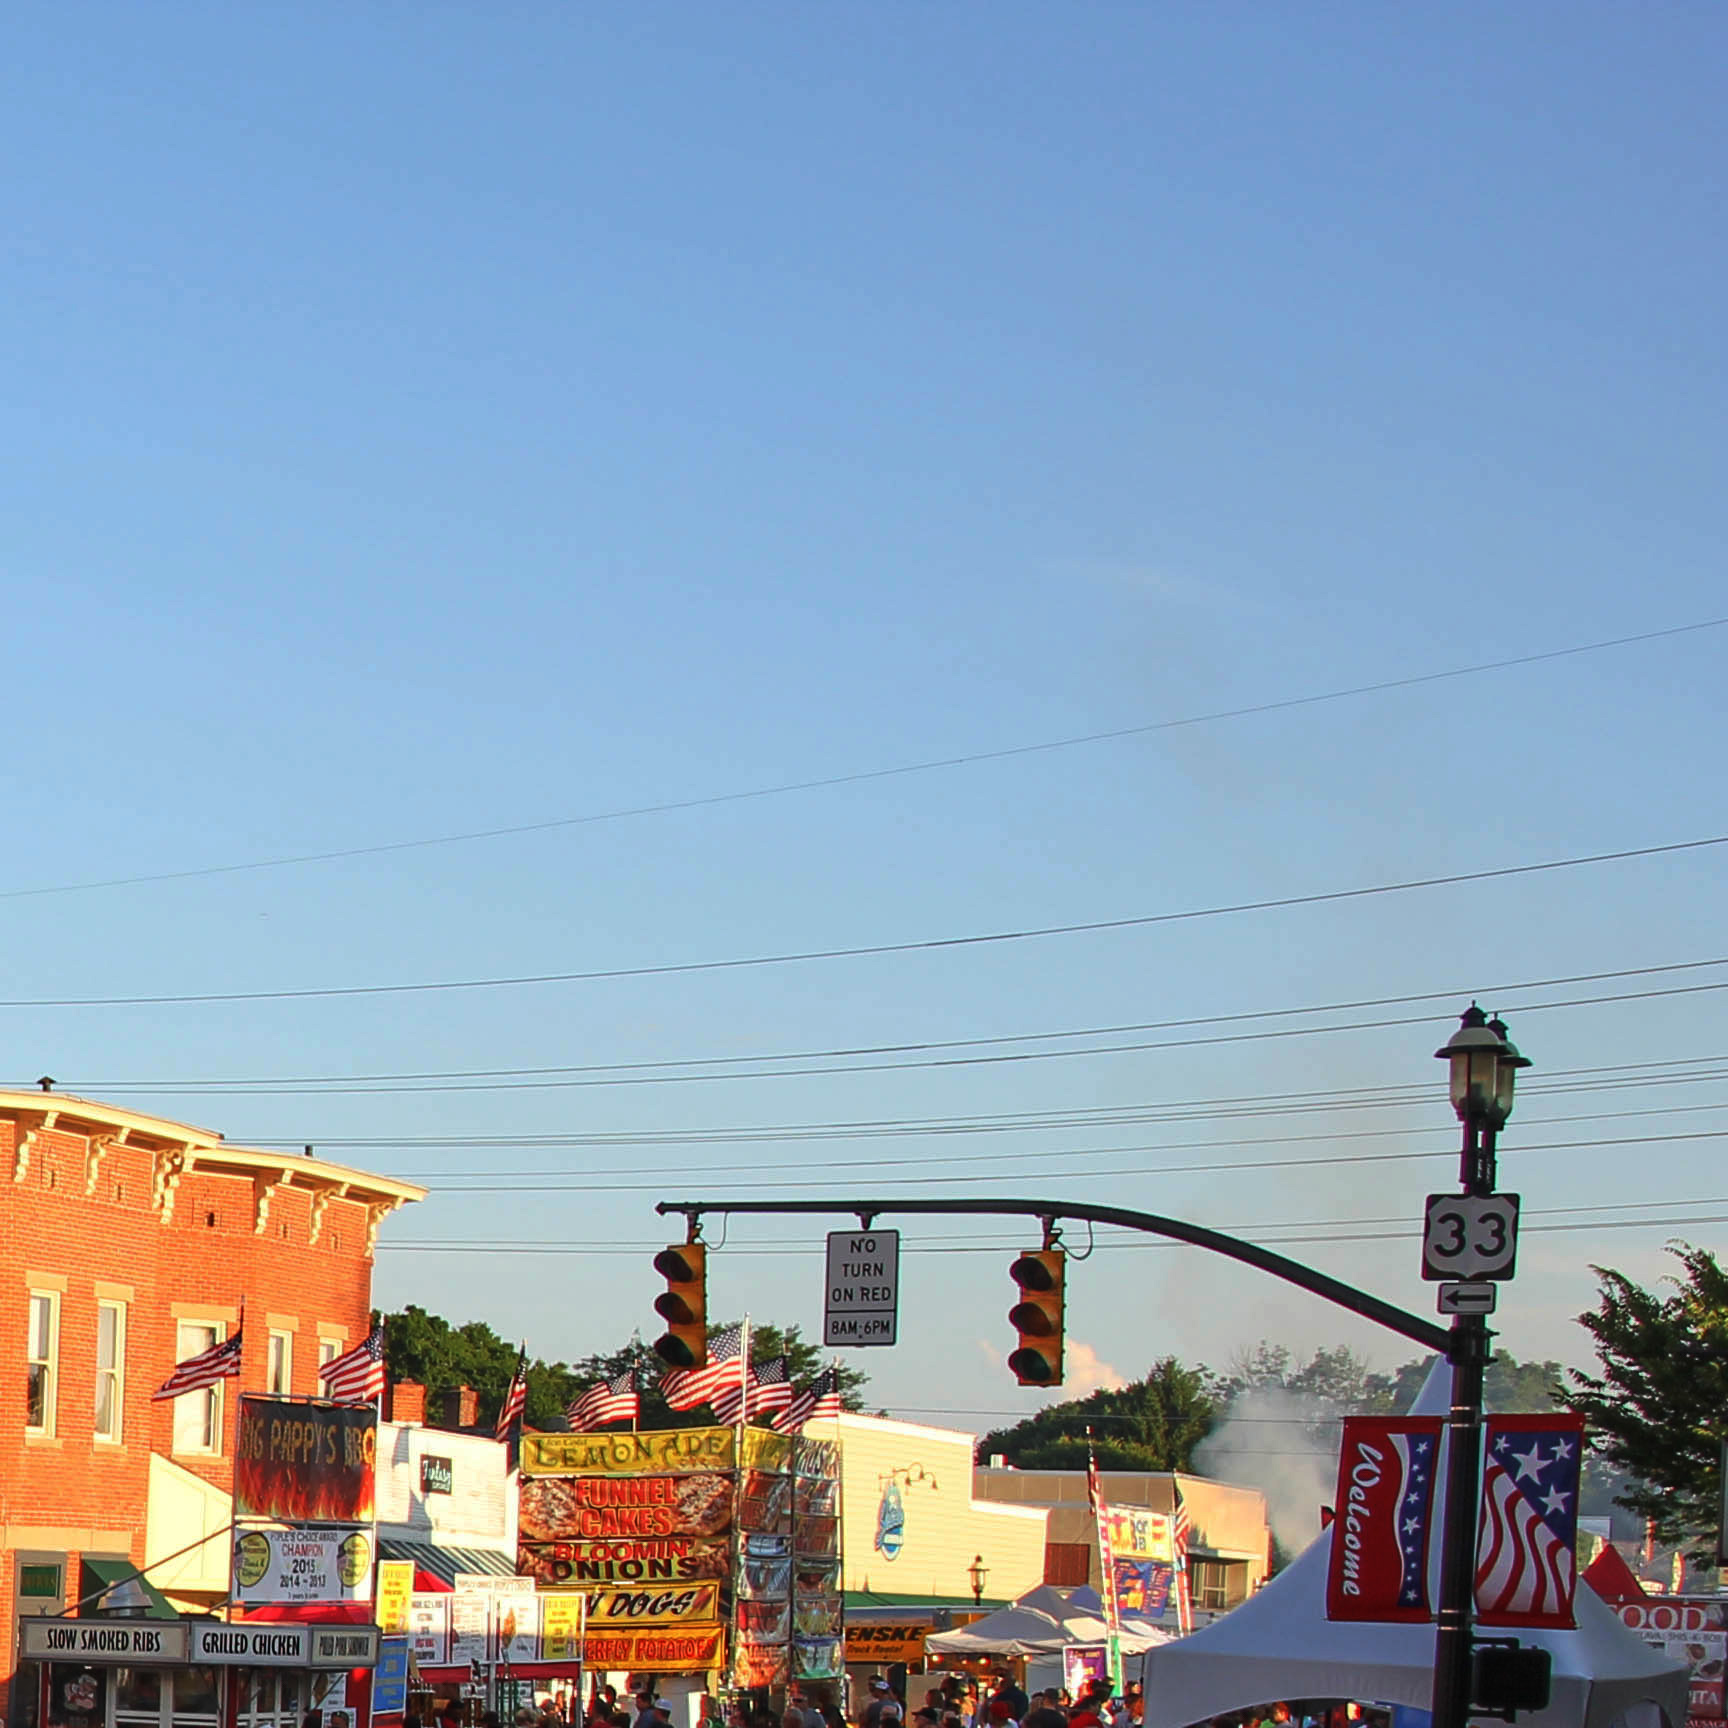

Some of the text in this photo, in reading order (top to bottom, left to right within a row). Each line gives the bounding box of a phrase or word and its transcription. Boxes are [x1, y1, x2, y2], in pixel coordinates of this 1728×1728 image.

[850, 1239, 876, 1253] NO
[1433, 1212, 1506, 1257] 33
[842, 1262, 884, 1277] TURN
[832, 1286, 891, 1302] ON RED
[242, 1417, 377, 1473] BIG PAPPY'S BBQ
[533, 1435, 725, 1469] LEMONADE
[575, 1476, 678, 1508] FUNNEL
[580, 1507, 672, 1537] CAKES
[1343, 1442, 1384, 1596] Welcome
[281, 1544, 324, 1557] CHAMPION
[292, 1559, 316, 1574] 2015
[551, 1557, 697, 1580] ONIONS
[280, 1575, 300, 1588] 2014
[608, 1590, 697, 1617] DOGS
[1608, 1603, 1707, 1632] OOD
[47, 1627, 162, 1653] SLOW SMOKED RIBS
[202, 1631, 301, 1657] GRILLED CHICKEN
[846, 1626, 924, 1642] ENSKE
[637, 1637, 716, 1661] POTATOES
